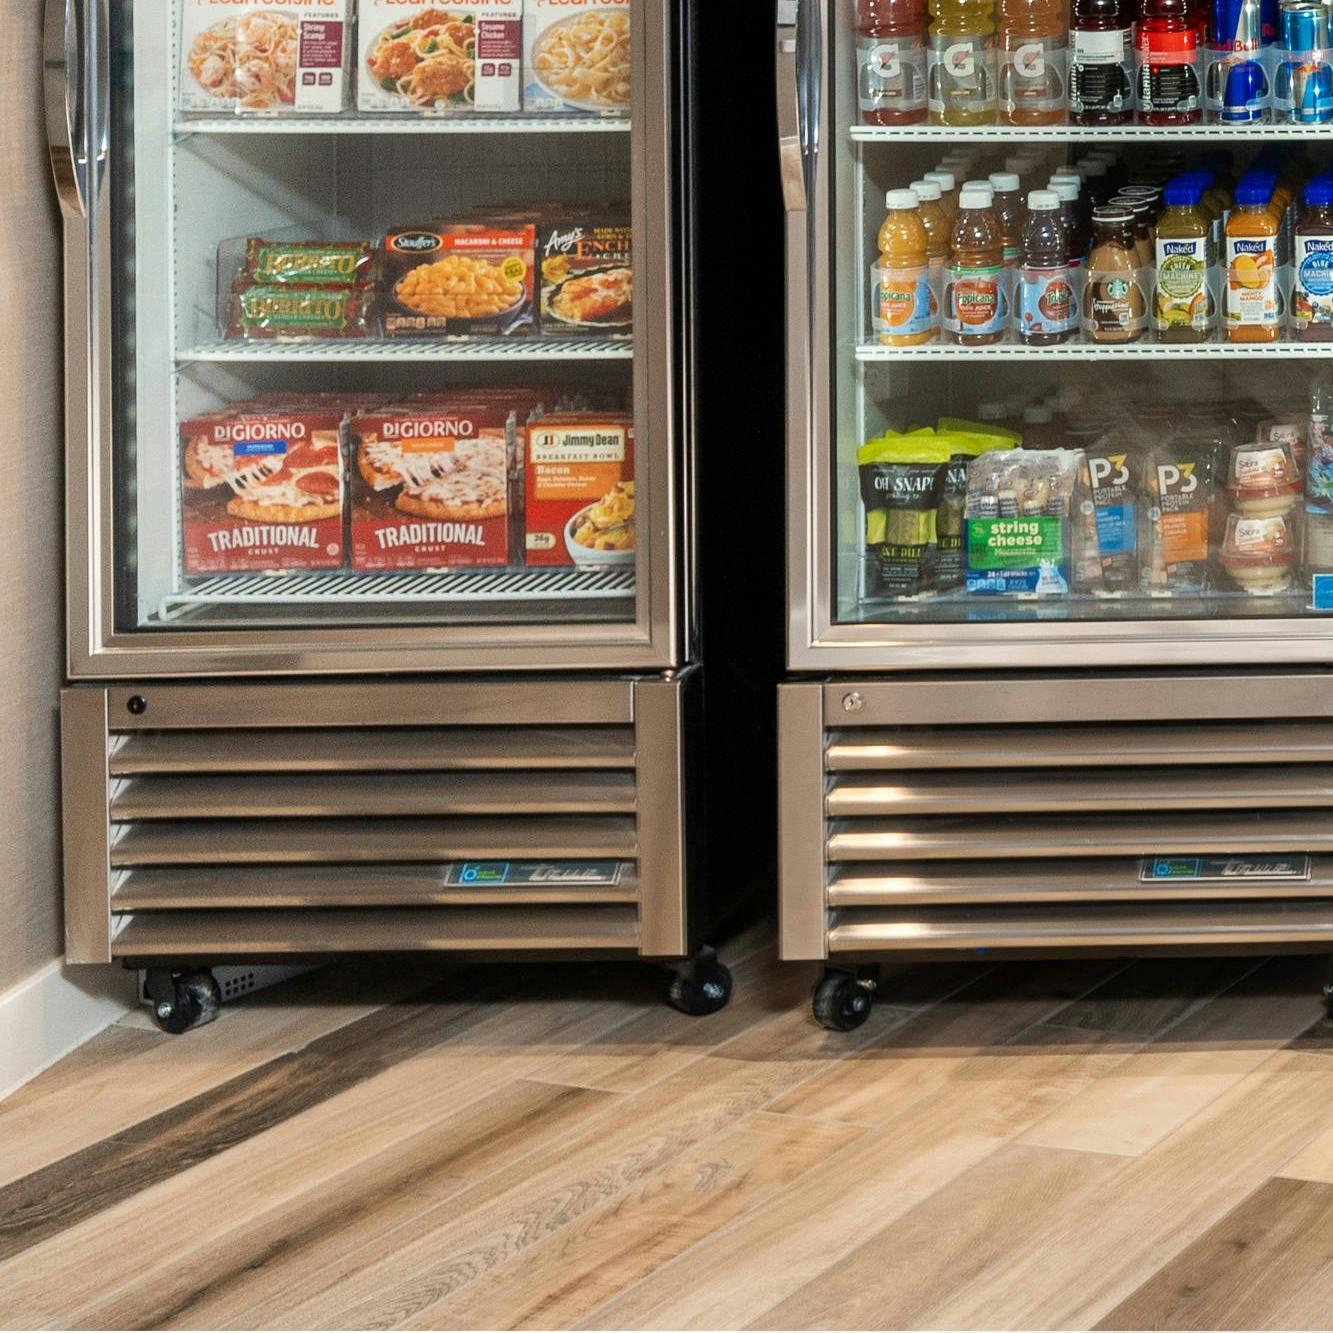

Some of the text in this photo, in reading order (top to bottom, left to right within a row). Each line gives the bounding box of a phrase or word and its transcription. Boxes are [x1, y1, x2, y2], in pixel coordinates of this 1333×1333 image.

[454, 238, 490, 246] MACARONI
[498, 237, 524, 245] CHEESE
[1166, 242, 1195, 254] Naked
[562, 433, 619, 447] Jimmy Dean
[1088, 454, 1130, 489] P3
[1157, 462, 1198, 497] P3
[374, 522, 486, 550] TRADITIONAL
[989, 520, 1039, 536] string
[207, 522, 320, 551] TRADITIONAL
[988, 534, 1043, 547] cheese
